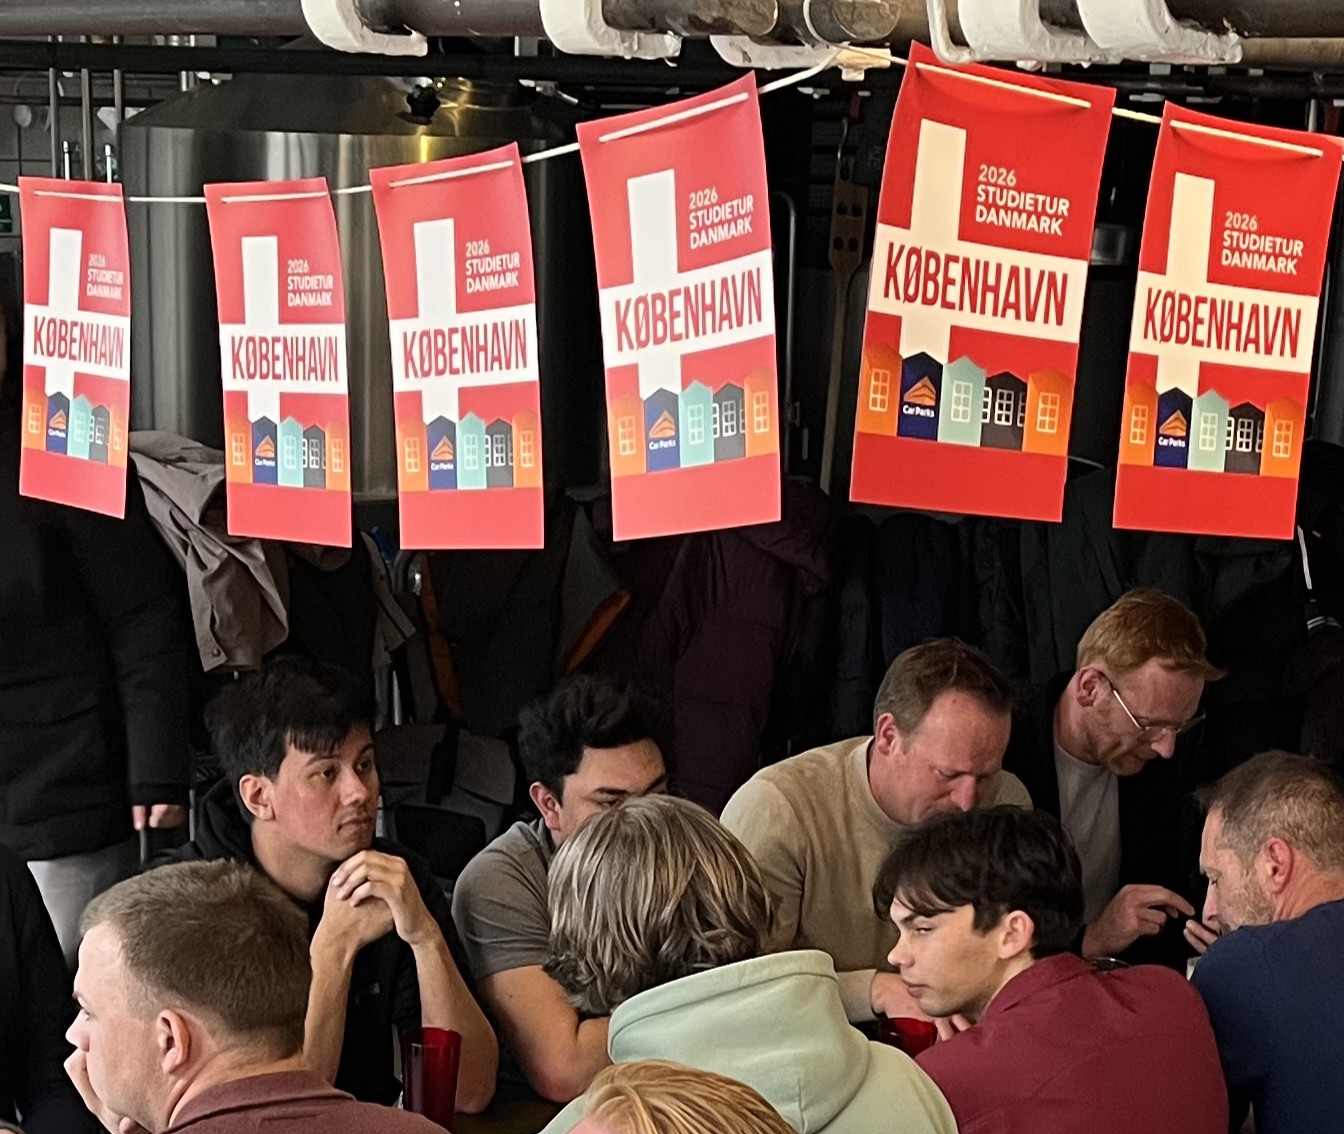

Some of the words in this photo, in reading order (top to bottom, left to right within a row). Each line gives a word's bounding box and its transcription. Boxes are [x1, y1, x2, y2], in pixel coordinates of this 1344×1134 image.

[978, 164, 1016, 187] 2026
[688, 187, 718, 209] 2026
[976, 185, 1070, 217] STUDIETUR
[689, 194, 754, 230] STUDIETUR
[975, 205, 1063, 236] DANMARK
[1224, 211, 1258, 231] 2026
[690, 215, 752, 250] DANMARK
[1223, 230, 1304, 257] STUDIETUR
[465, 240, 490, 257] 2026
[287, 259, 309, 273] 2026
[465, 252, 520, 276] STUDIETUR
[1221, 249, 1298, 275] DANMARK
[87, 268, 123, 286] STUDIETUR
[287, 275, 333, 290] STUDIETUR
[466, 271, 519, 294] DANMARK
[883, 241, 1068, 327] KØBENHAVN
[87, 283, 122, 300] DANMARK
[287, 292, 332, 307] DANMARK
[614, 267, 762, 352] KØBENHAVN
[1143, 287, 1302, 359] KØBENHAVN
[33, 315, 124, 369] KØBENHAVN
[402, 318, 527, 381] KØBENHAVN
[231, 335, 338, 382] KØBENHAVN
[916, 406, 935, 418] Parks
